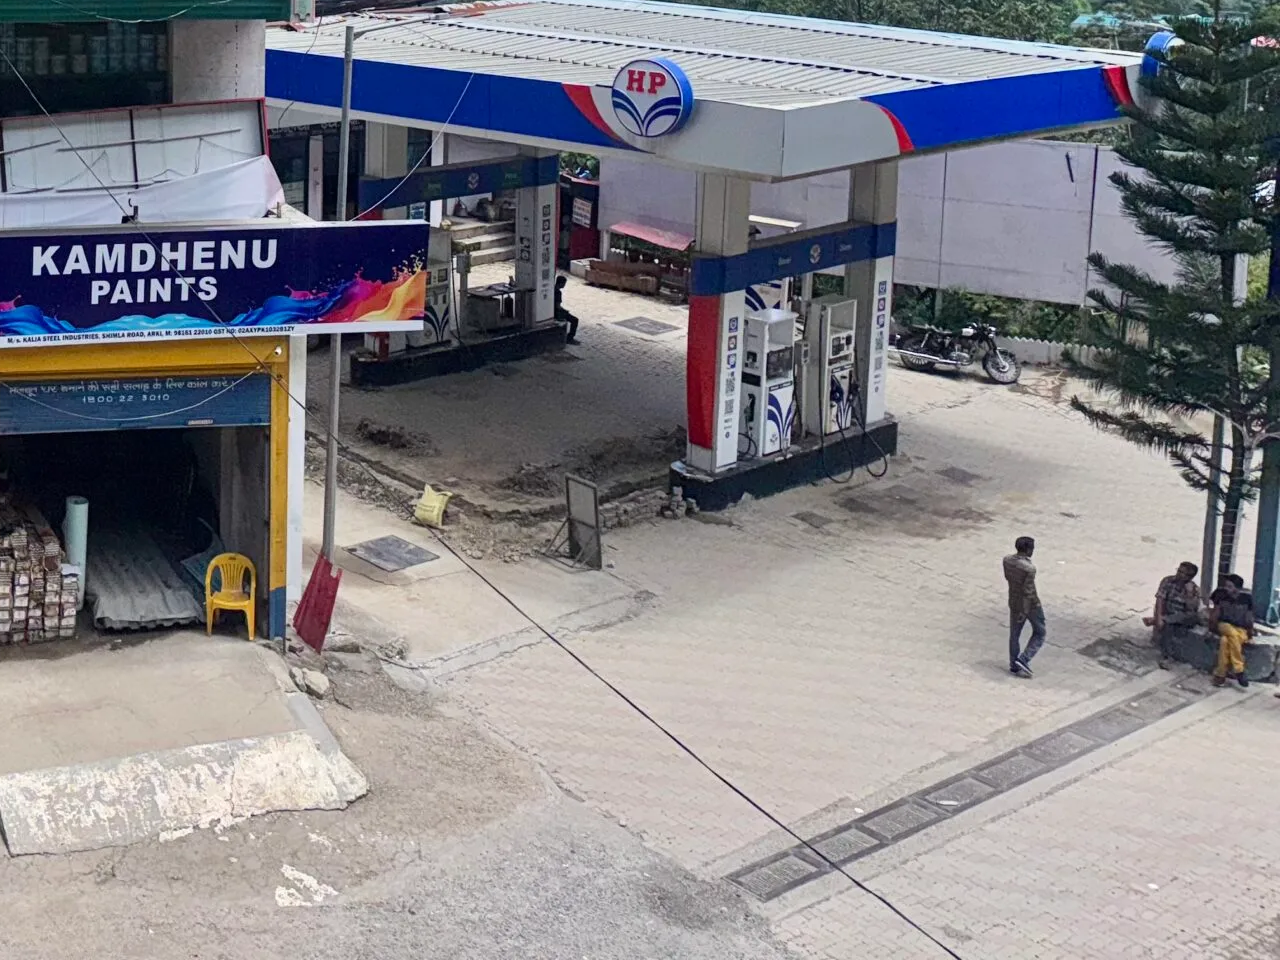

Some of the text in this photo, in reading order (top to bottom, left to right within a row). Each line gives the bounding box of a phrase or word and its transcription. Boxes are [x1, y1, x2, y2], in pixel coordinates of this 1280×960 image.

[626, 69, 667, 95] HP
[31, 238, 278, 276] KAMDHENU
[90, 275, 218, 305] PAINTS
[82, 395, 113, 404] 1800
